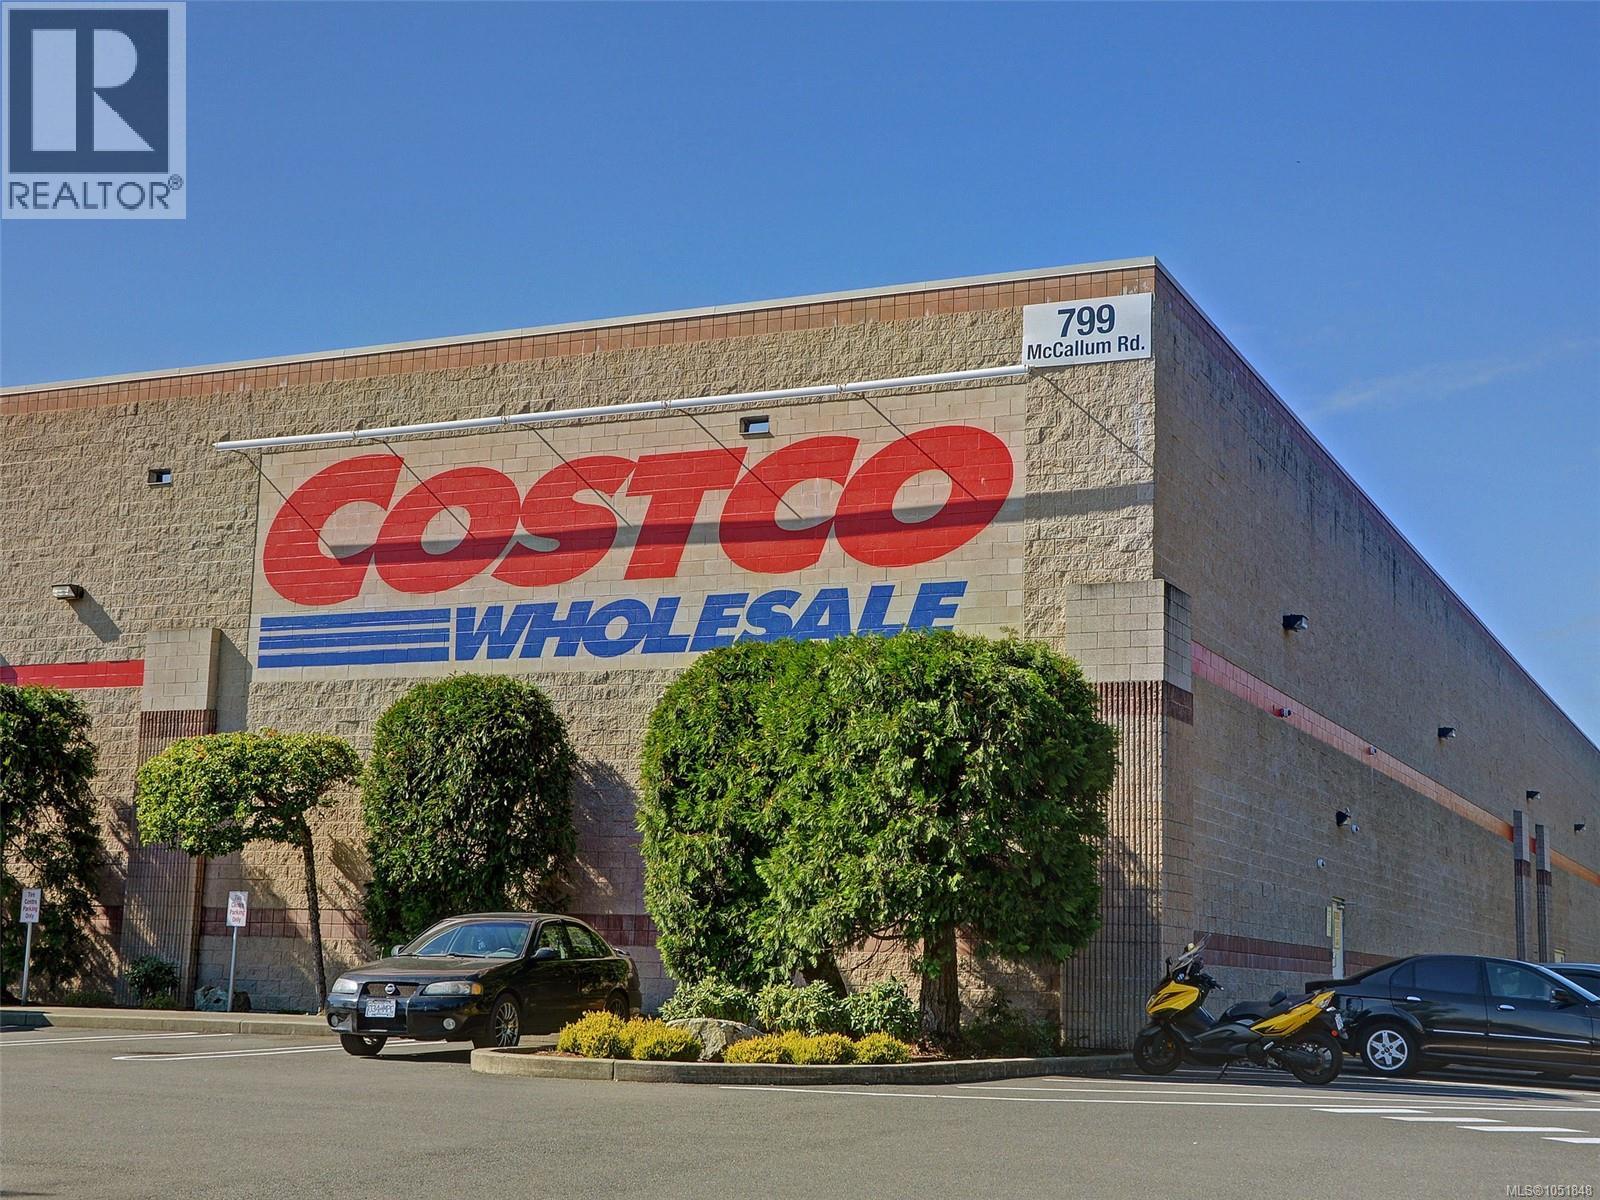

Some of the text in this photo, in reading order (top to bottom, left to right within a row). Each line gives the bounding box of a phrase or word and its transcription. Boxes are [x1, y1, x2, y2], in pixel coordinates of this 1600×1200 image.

[1026, 334, 1145, 360] McCallum Rd.
[1057, 303, 1116, 338] 799
[262, 425, 1015, 606] COSTCO
[455, 580, 968, 661] WHOLESALE
